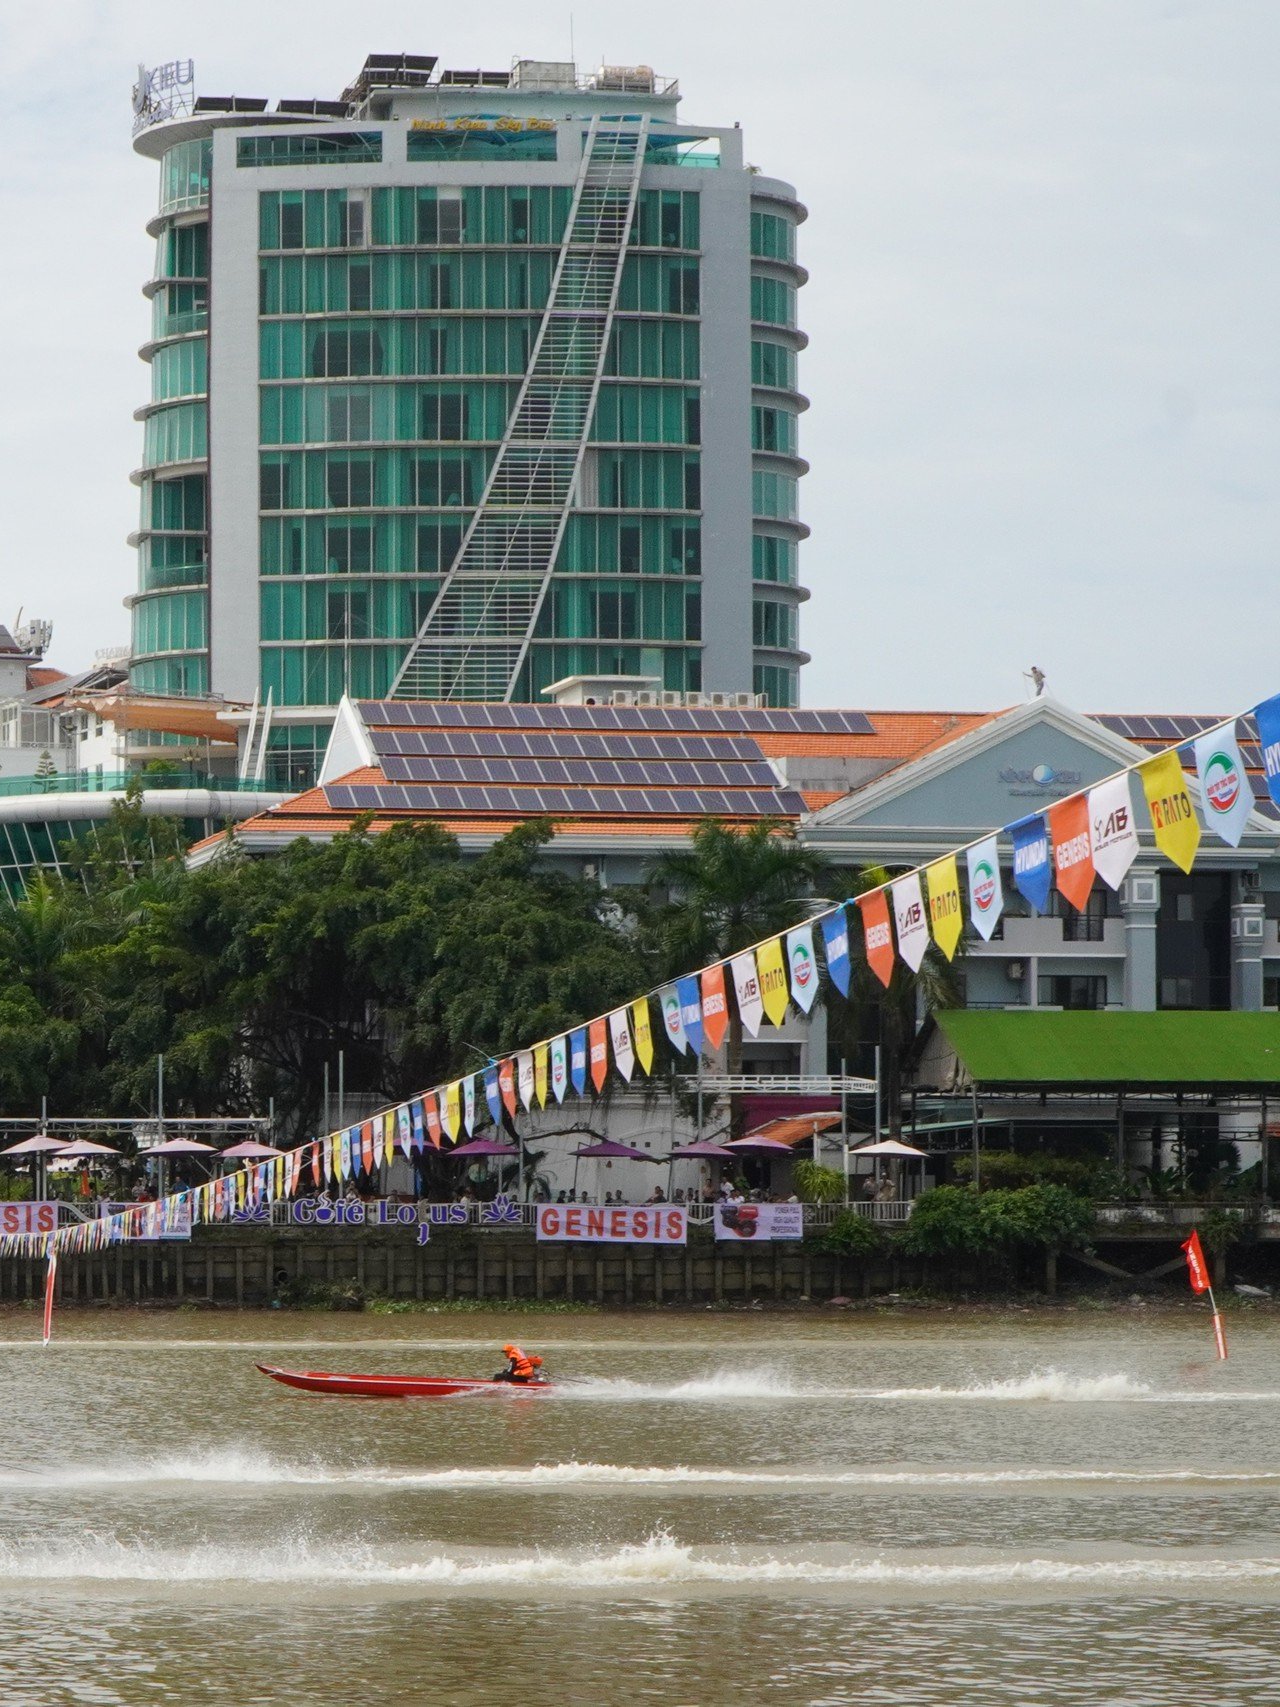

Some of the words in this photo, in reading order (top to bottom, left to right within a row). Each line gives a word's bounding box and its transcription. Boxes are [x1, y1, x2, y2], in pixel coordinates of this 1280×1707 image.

[1103, 806, 1128, 838] AB
[1162, 792, 1191, 825] RATO
[905, 902, 921, 928] AB
[541, 1208, 683, 1239] GENESIS
